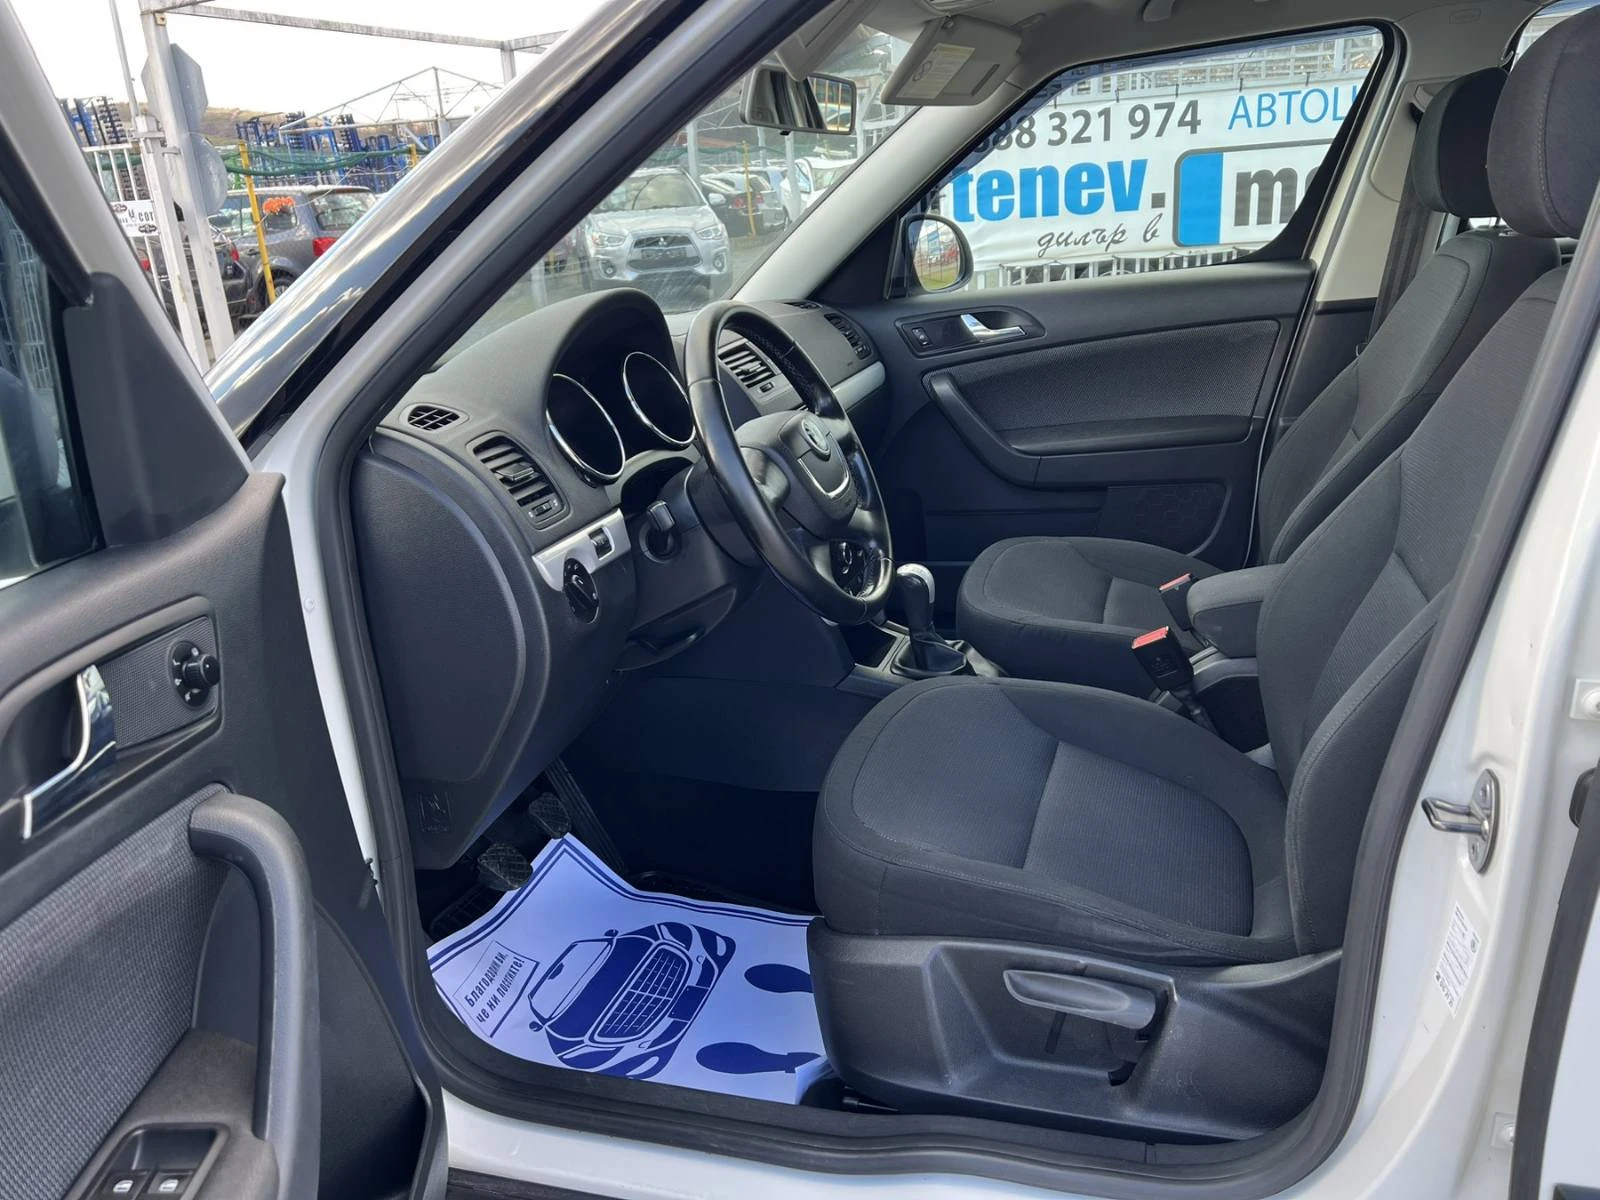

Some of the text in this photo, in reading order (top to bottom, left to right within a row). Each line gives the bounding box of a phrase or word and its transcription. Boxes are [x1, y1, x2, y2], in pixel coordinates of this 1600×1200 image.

[1047, 107, 1112, 147] 321
[1128, 99, 1202, 141] 974
[1233, 165, 1320, 226] m
[476, 1008, 490, 1023] че
[486, 994, 501, 1012] ни
